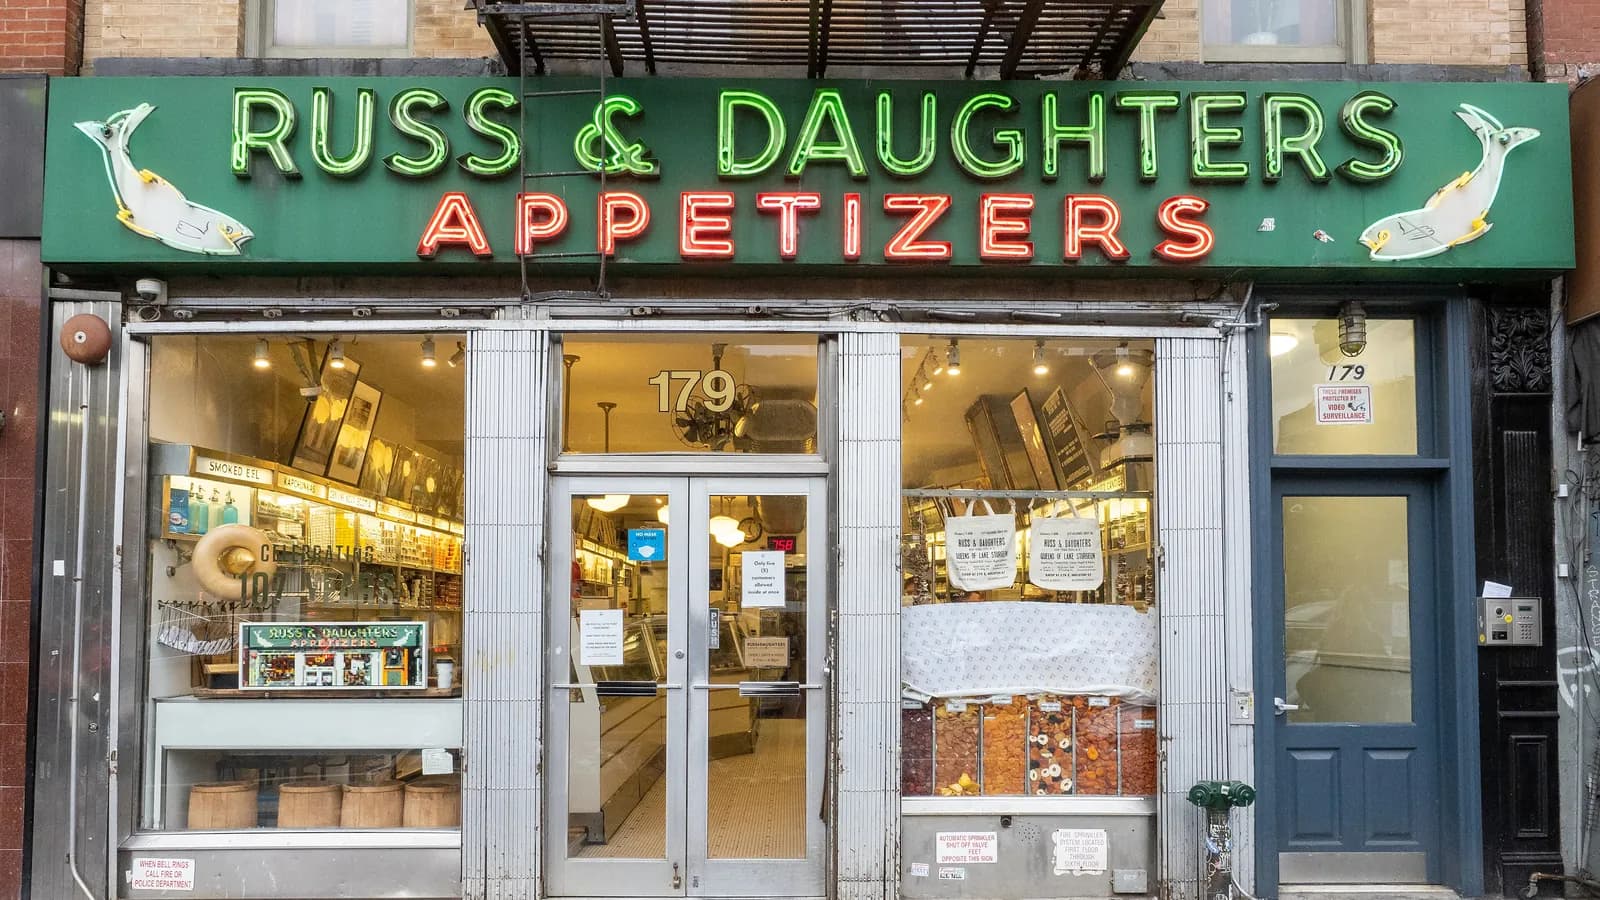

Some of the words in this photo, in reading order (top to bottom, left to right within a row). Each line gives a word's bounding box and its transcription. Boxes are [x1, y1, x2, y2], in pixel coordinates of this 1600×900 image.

[230, 86, 523, 177] RUSS
[573, 94, 660, 179] &
[717, 88, 1406, 184] DAUGHTERS
[417, 190, 1215, 261] APPETIZERS
[1328, 364, 1365, 381] 179
[648, 369, 737, 413] 179
[1323, 412, 1366, 420] SURVEILLANCE
[208, 460, 243, 477] SMOKED
[246, 467, 260, 480] EEL
[958, 538, 971, 548] RUSS
[979, 536, 1006, 548] DAUGHTERS
[1043, 538, 1056, 548] RUSS
[1065, 538, 1092, 548] DAUGHTERS
[260, 543, 375, 565] CELEBRATING
[139, 860, 156, 868] WHEN
[157, 860, 171, 868] BELL
[172, 860, 189, 869] RINGS
[145, 870, 160, 878] CALL
[161, 870, 173, 878] FIRE
[174, 870, 183, 878] OR
[134, 879, 155, 888] POLICE
[155, 879, 192, 889] DEPARTMENT
